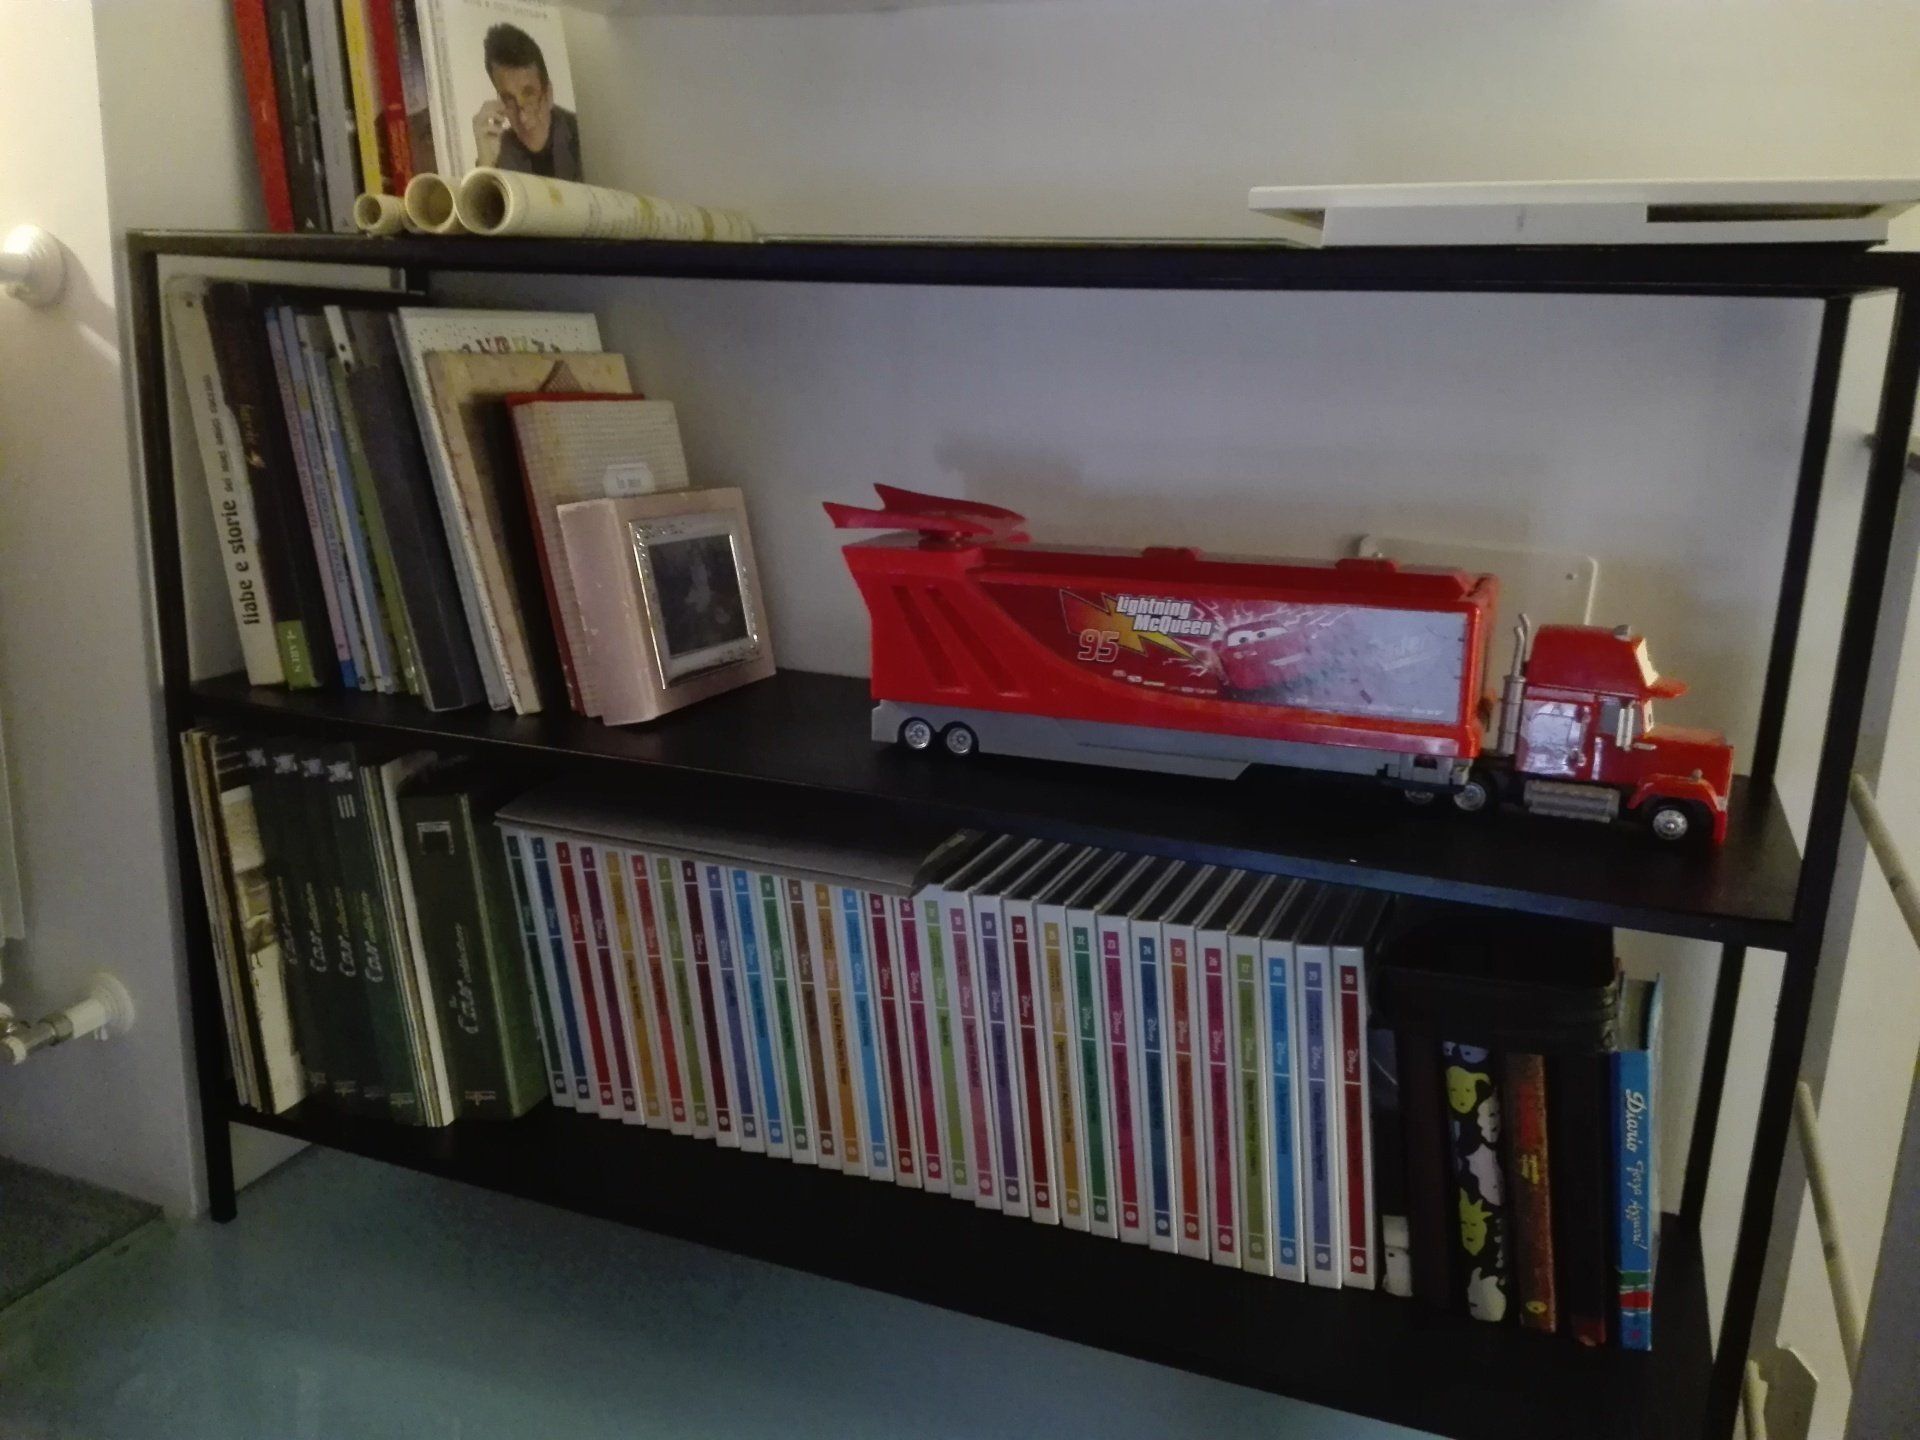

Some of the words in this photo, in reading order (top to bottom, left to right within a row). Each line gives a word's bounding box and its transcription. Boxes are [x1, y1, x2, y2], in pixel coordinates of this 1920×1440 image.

[226, 499, 246, 554] storie
[238, 560, 250, 573] e
[237, 578, 259, 625] fiabe
[1116, 594, 1193, 620] Lightning
[1076, 628, 1121, 664] 95
[1133, 614, 1213, 637] McQueen
[363, 940, 385, 983] Car
[455, 980, 480, 1035] Car
[1624, 1088, 1646, 1154] Diario
